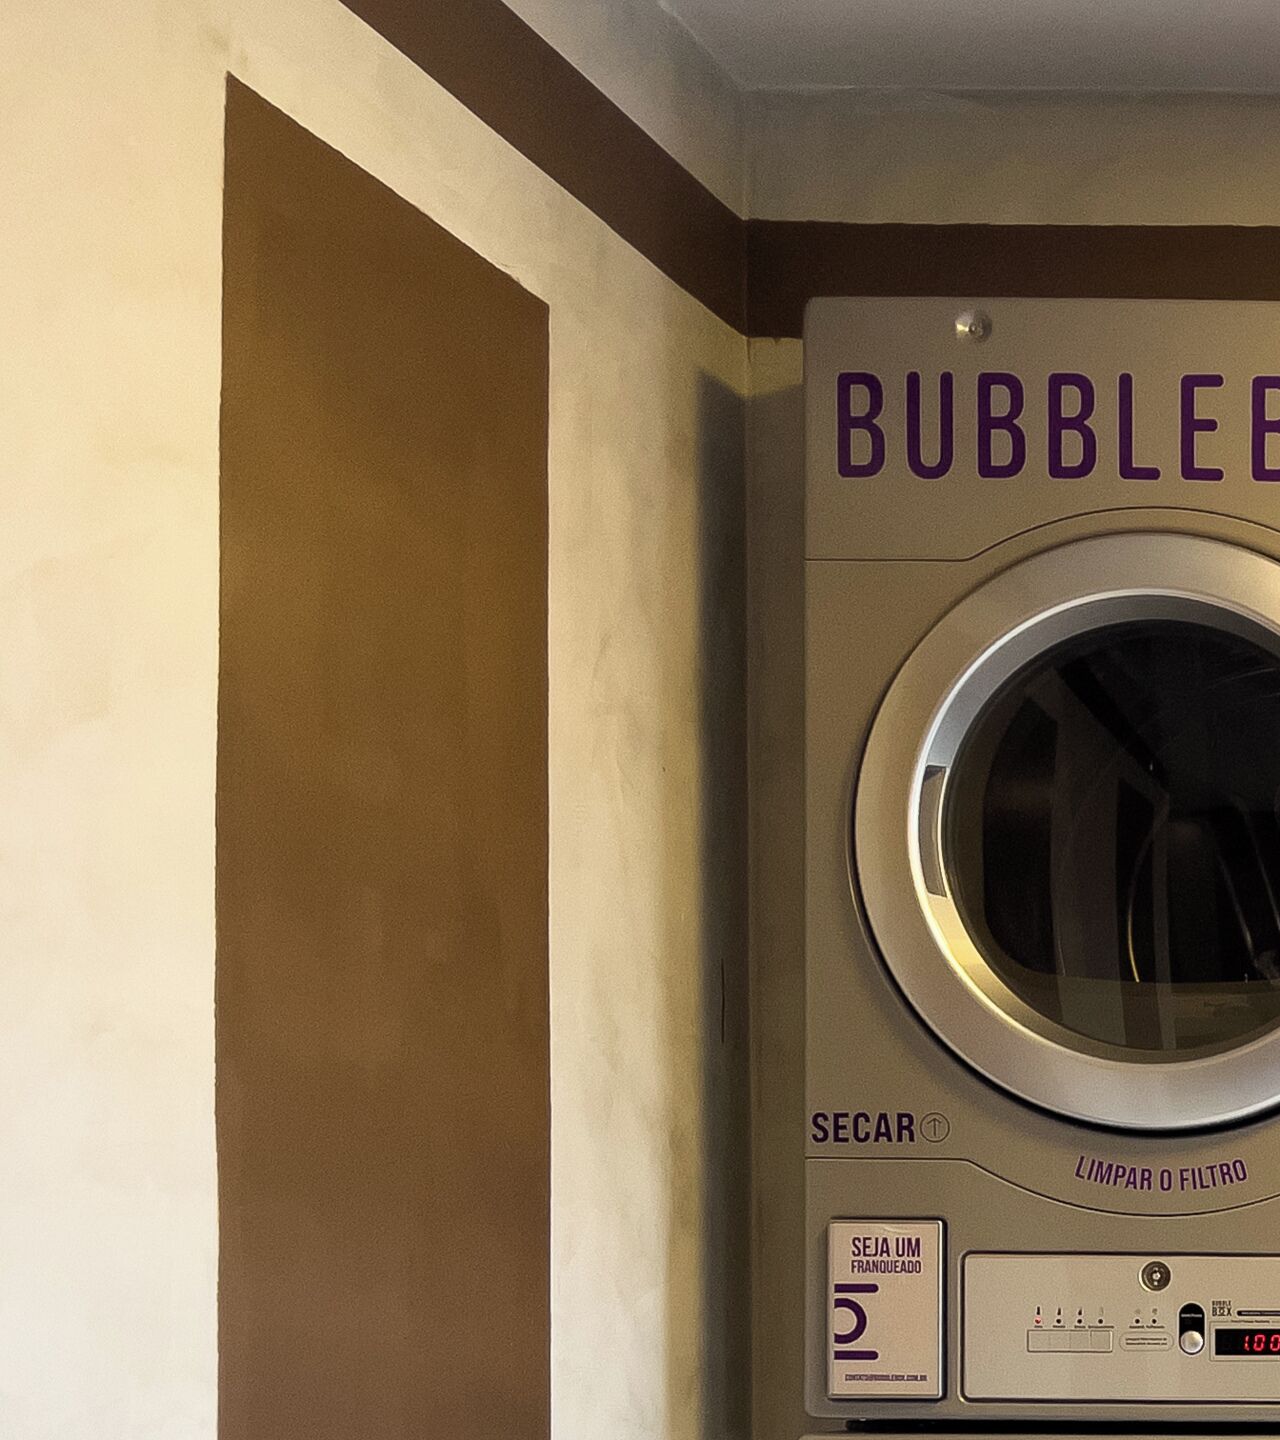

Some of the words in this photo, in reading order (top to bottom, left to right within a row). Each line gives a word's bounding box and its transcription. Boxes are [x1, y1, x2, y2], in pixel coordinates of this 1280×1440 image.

[811, 1111, 915, 1143] SECAR
[1075, 1155, 1152, 1191] LIMPAR
[1159, 1169, 1172, 1191] O
[1179, 1159, 1247, 1191] FILTRO
[852, 1237, 890, 1257] SEJA
[896, 1237, 920, 1257] UM
[851, 1260, 921, 1273] FRANQUEADO
